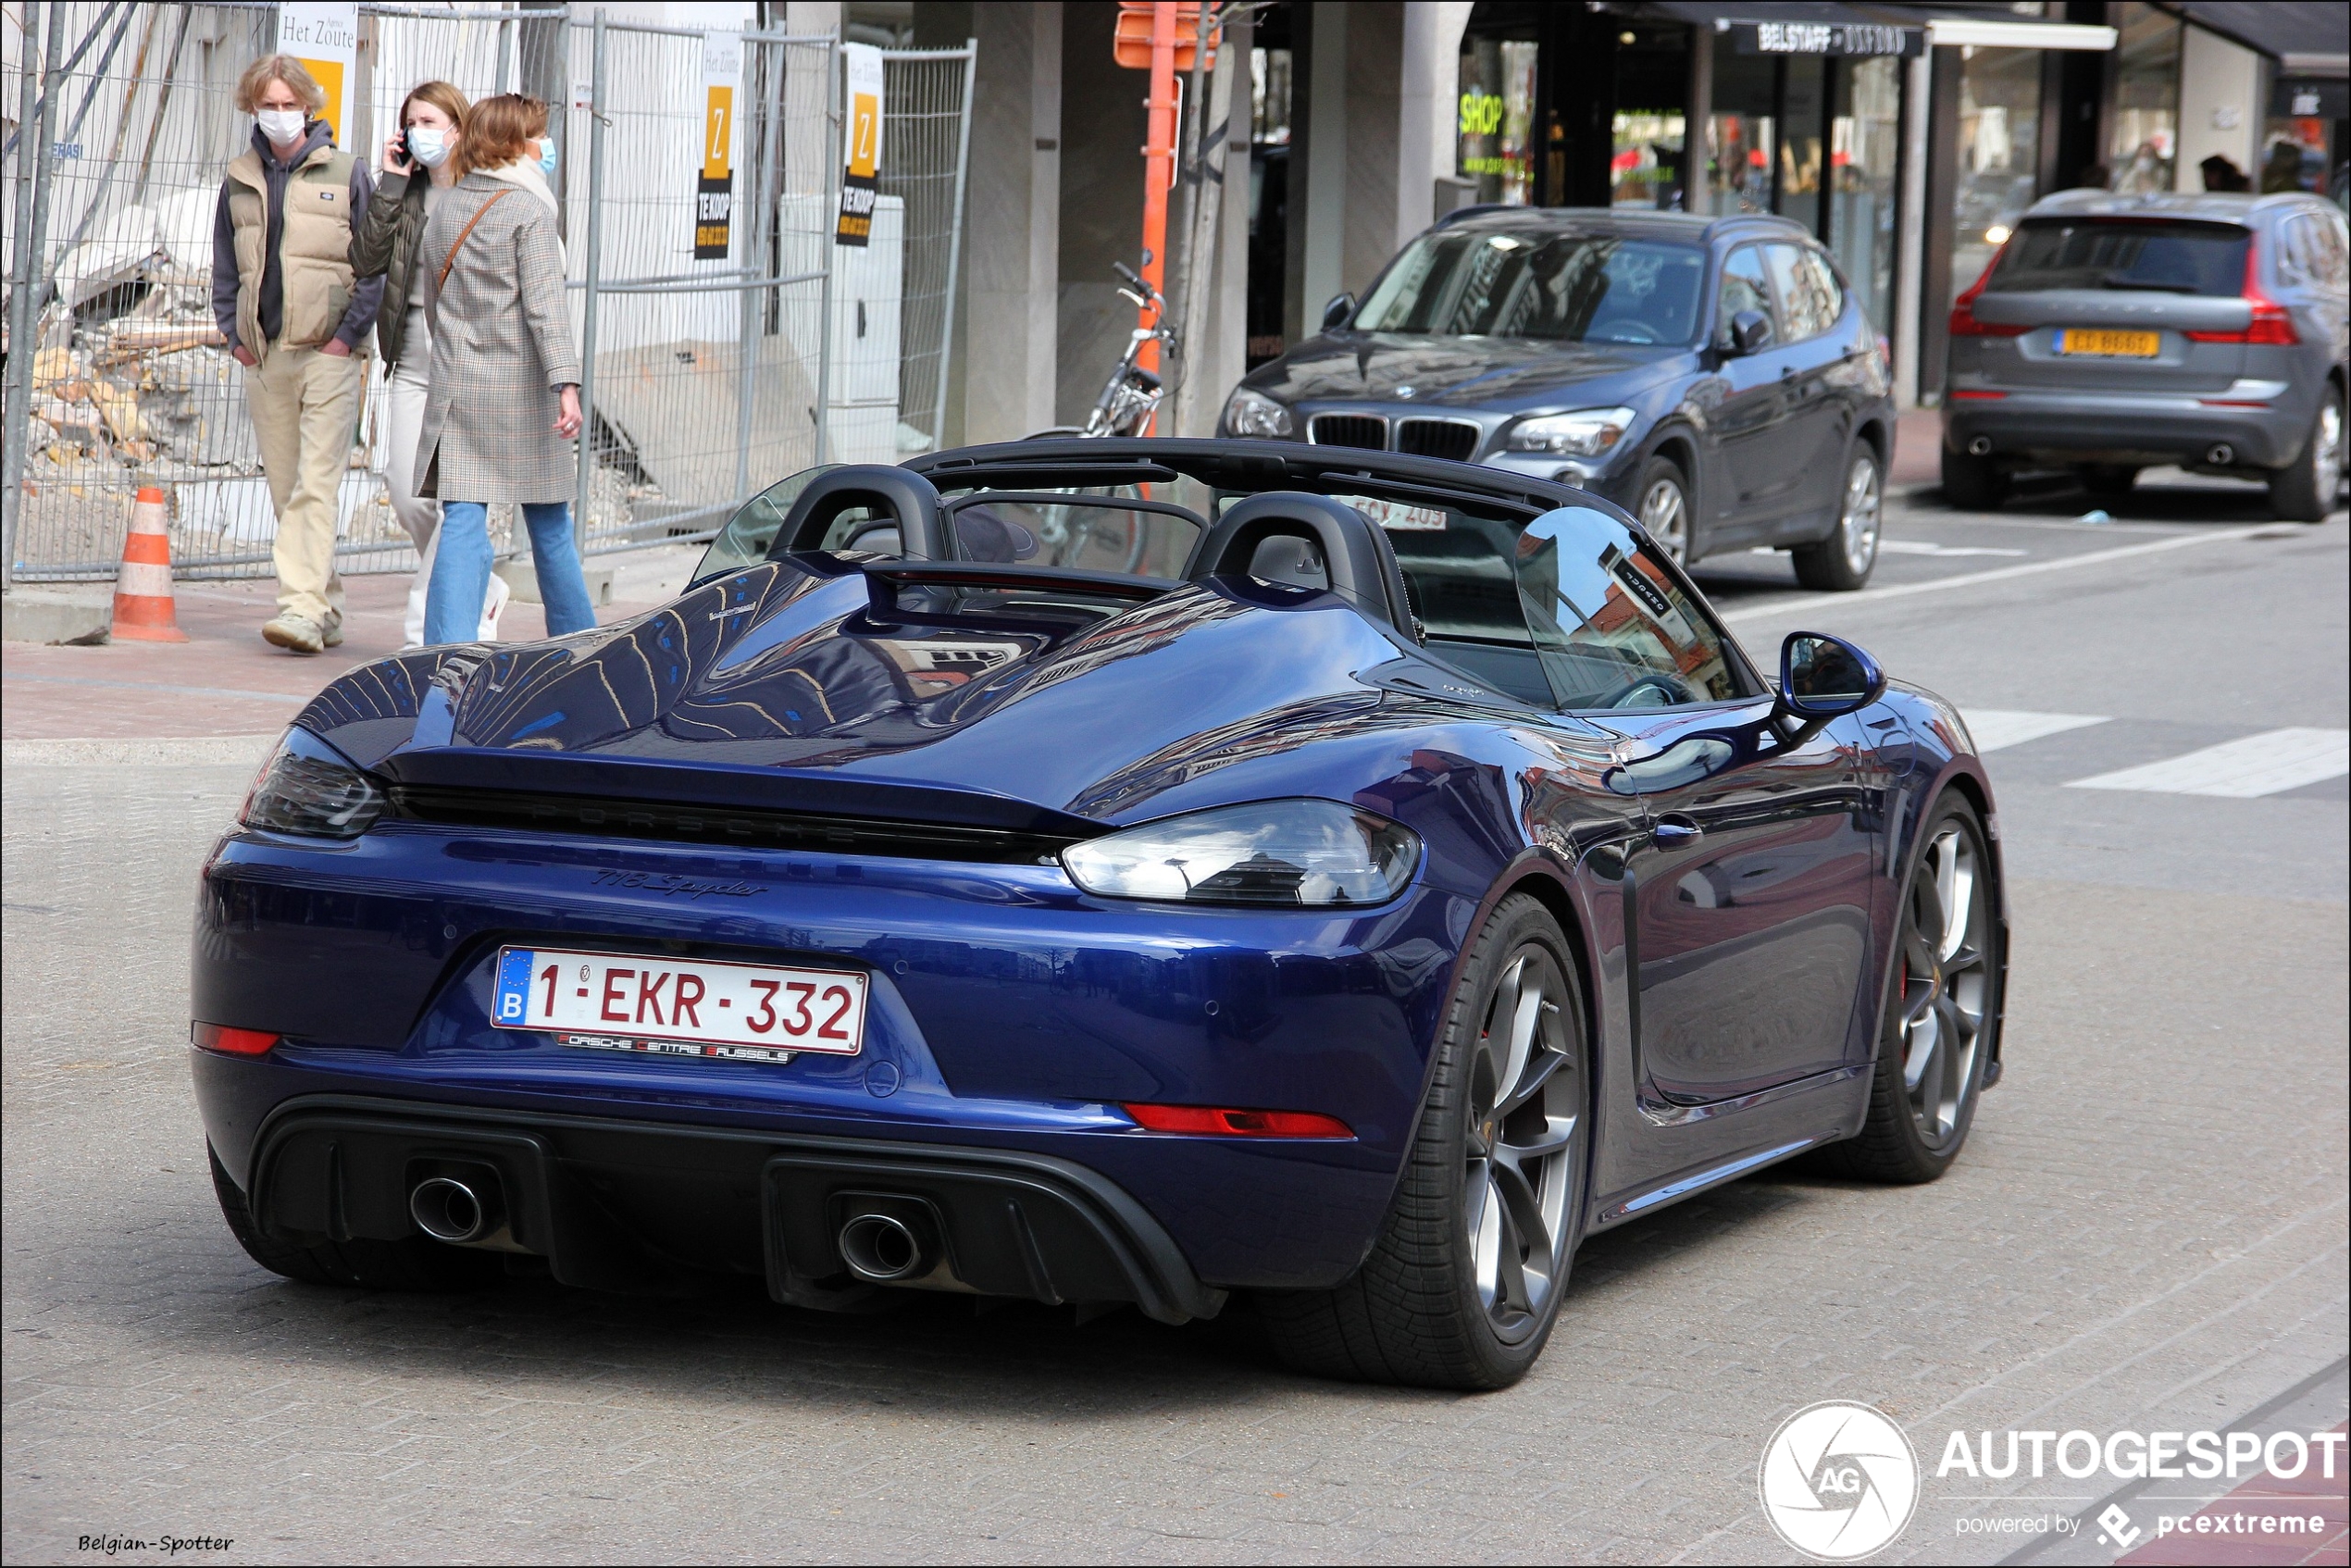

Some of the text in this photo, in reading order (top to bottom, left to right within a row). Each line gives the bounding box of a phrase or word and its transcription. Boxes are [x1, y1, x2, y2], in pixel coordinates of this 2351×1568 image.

[283, 16, 354, 48] Het Zoute
[1758, 22, 1831, 53] BELSTAFF
[1460, 93, 1503, 135] SHOP
[712, 107, 724, 159] Z
[858, 113, 870, 158] Z
[699, 193, 730, 221] TE KOOP
[842, 185, 876, 215] TE KOOP
[591, 868, 769, 900] 718 Spyder
[502, 992, 523, 1019] B
[558, 1034, 789, 1062] PORSCHE CENTRE BRUSSELS
